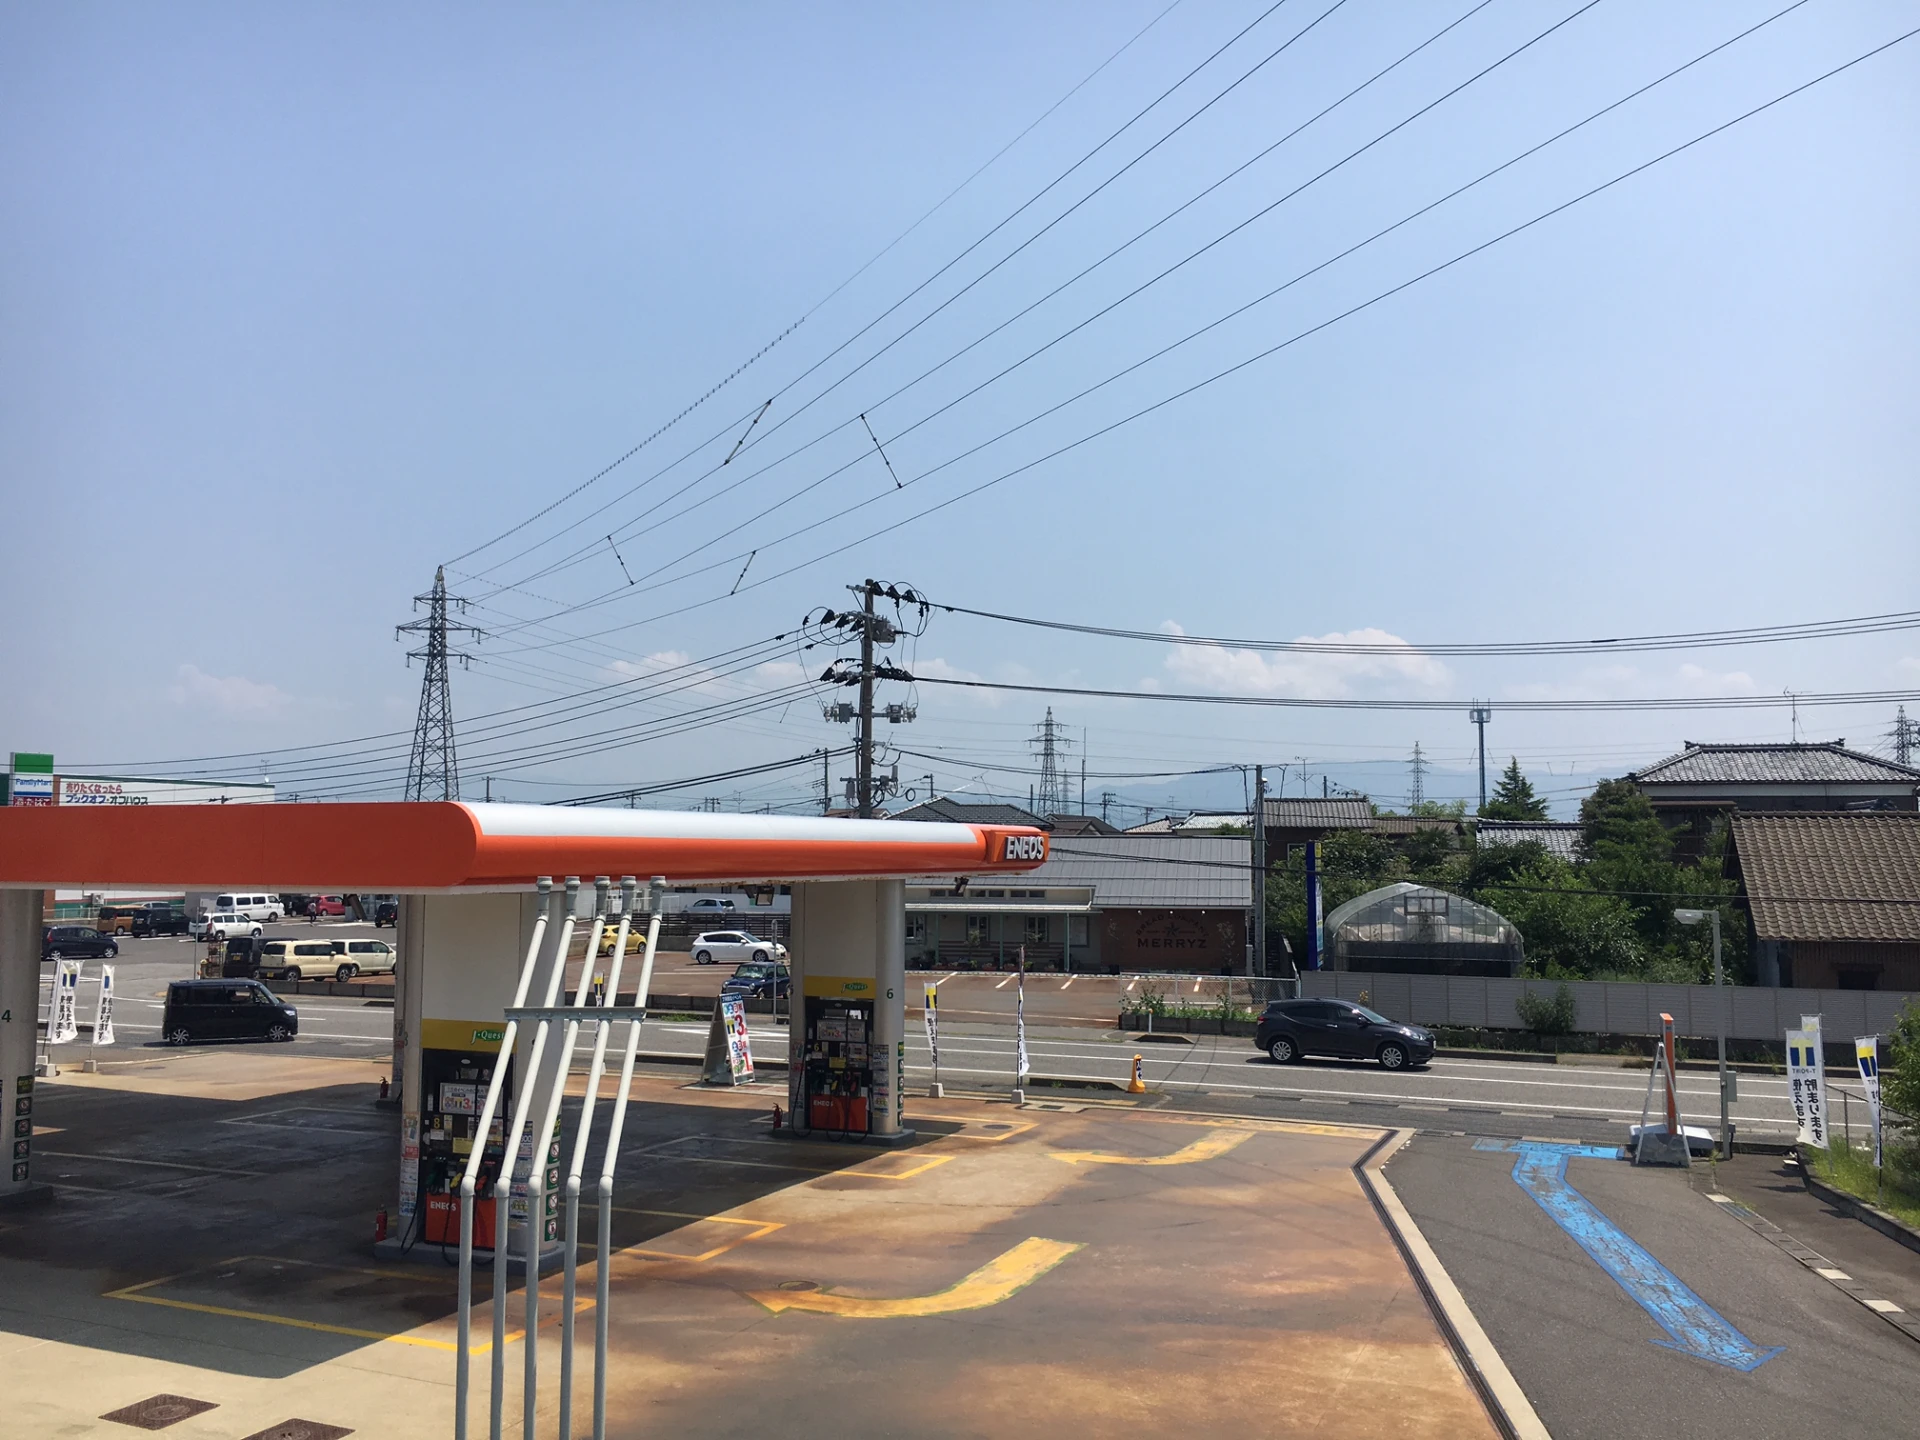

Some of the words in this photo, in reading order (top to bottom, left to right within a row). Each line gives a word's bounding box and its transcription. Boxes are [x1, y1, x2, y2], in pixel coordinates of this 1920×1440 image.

[15, 778, 52, 787] FamilyMart
[66, 783, 123, 794] 売りたくなったら
[1005, 836, 1045, 860] ENEOS
[1137, 938, 1208, 949] MERRYZ
[886, 988, 894, 999] 6
[1, 1009, 12, 1023] 4
[433, 1117, 440, 1129] 8
